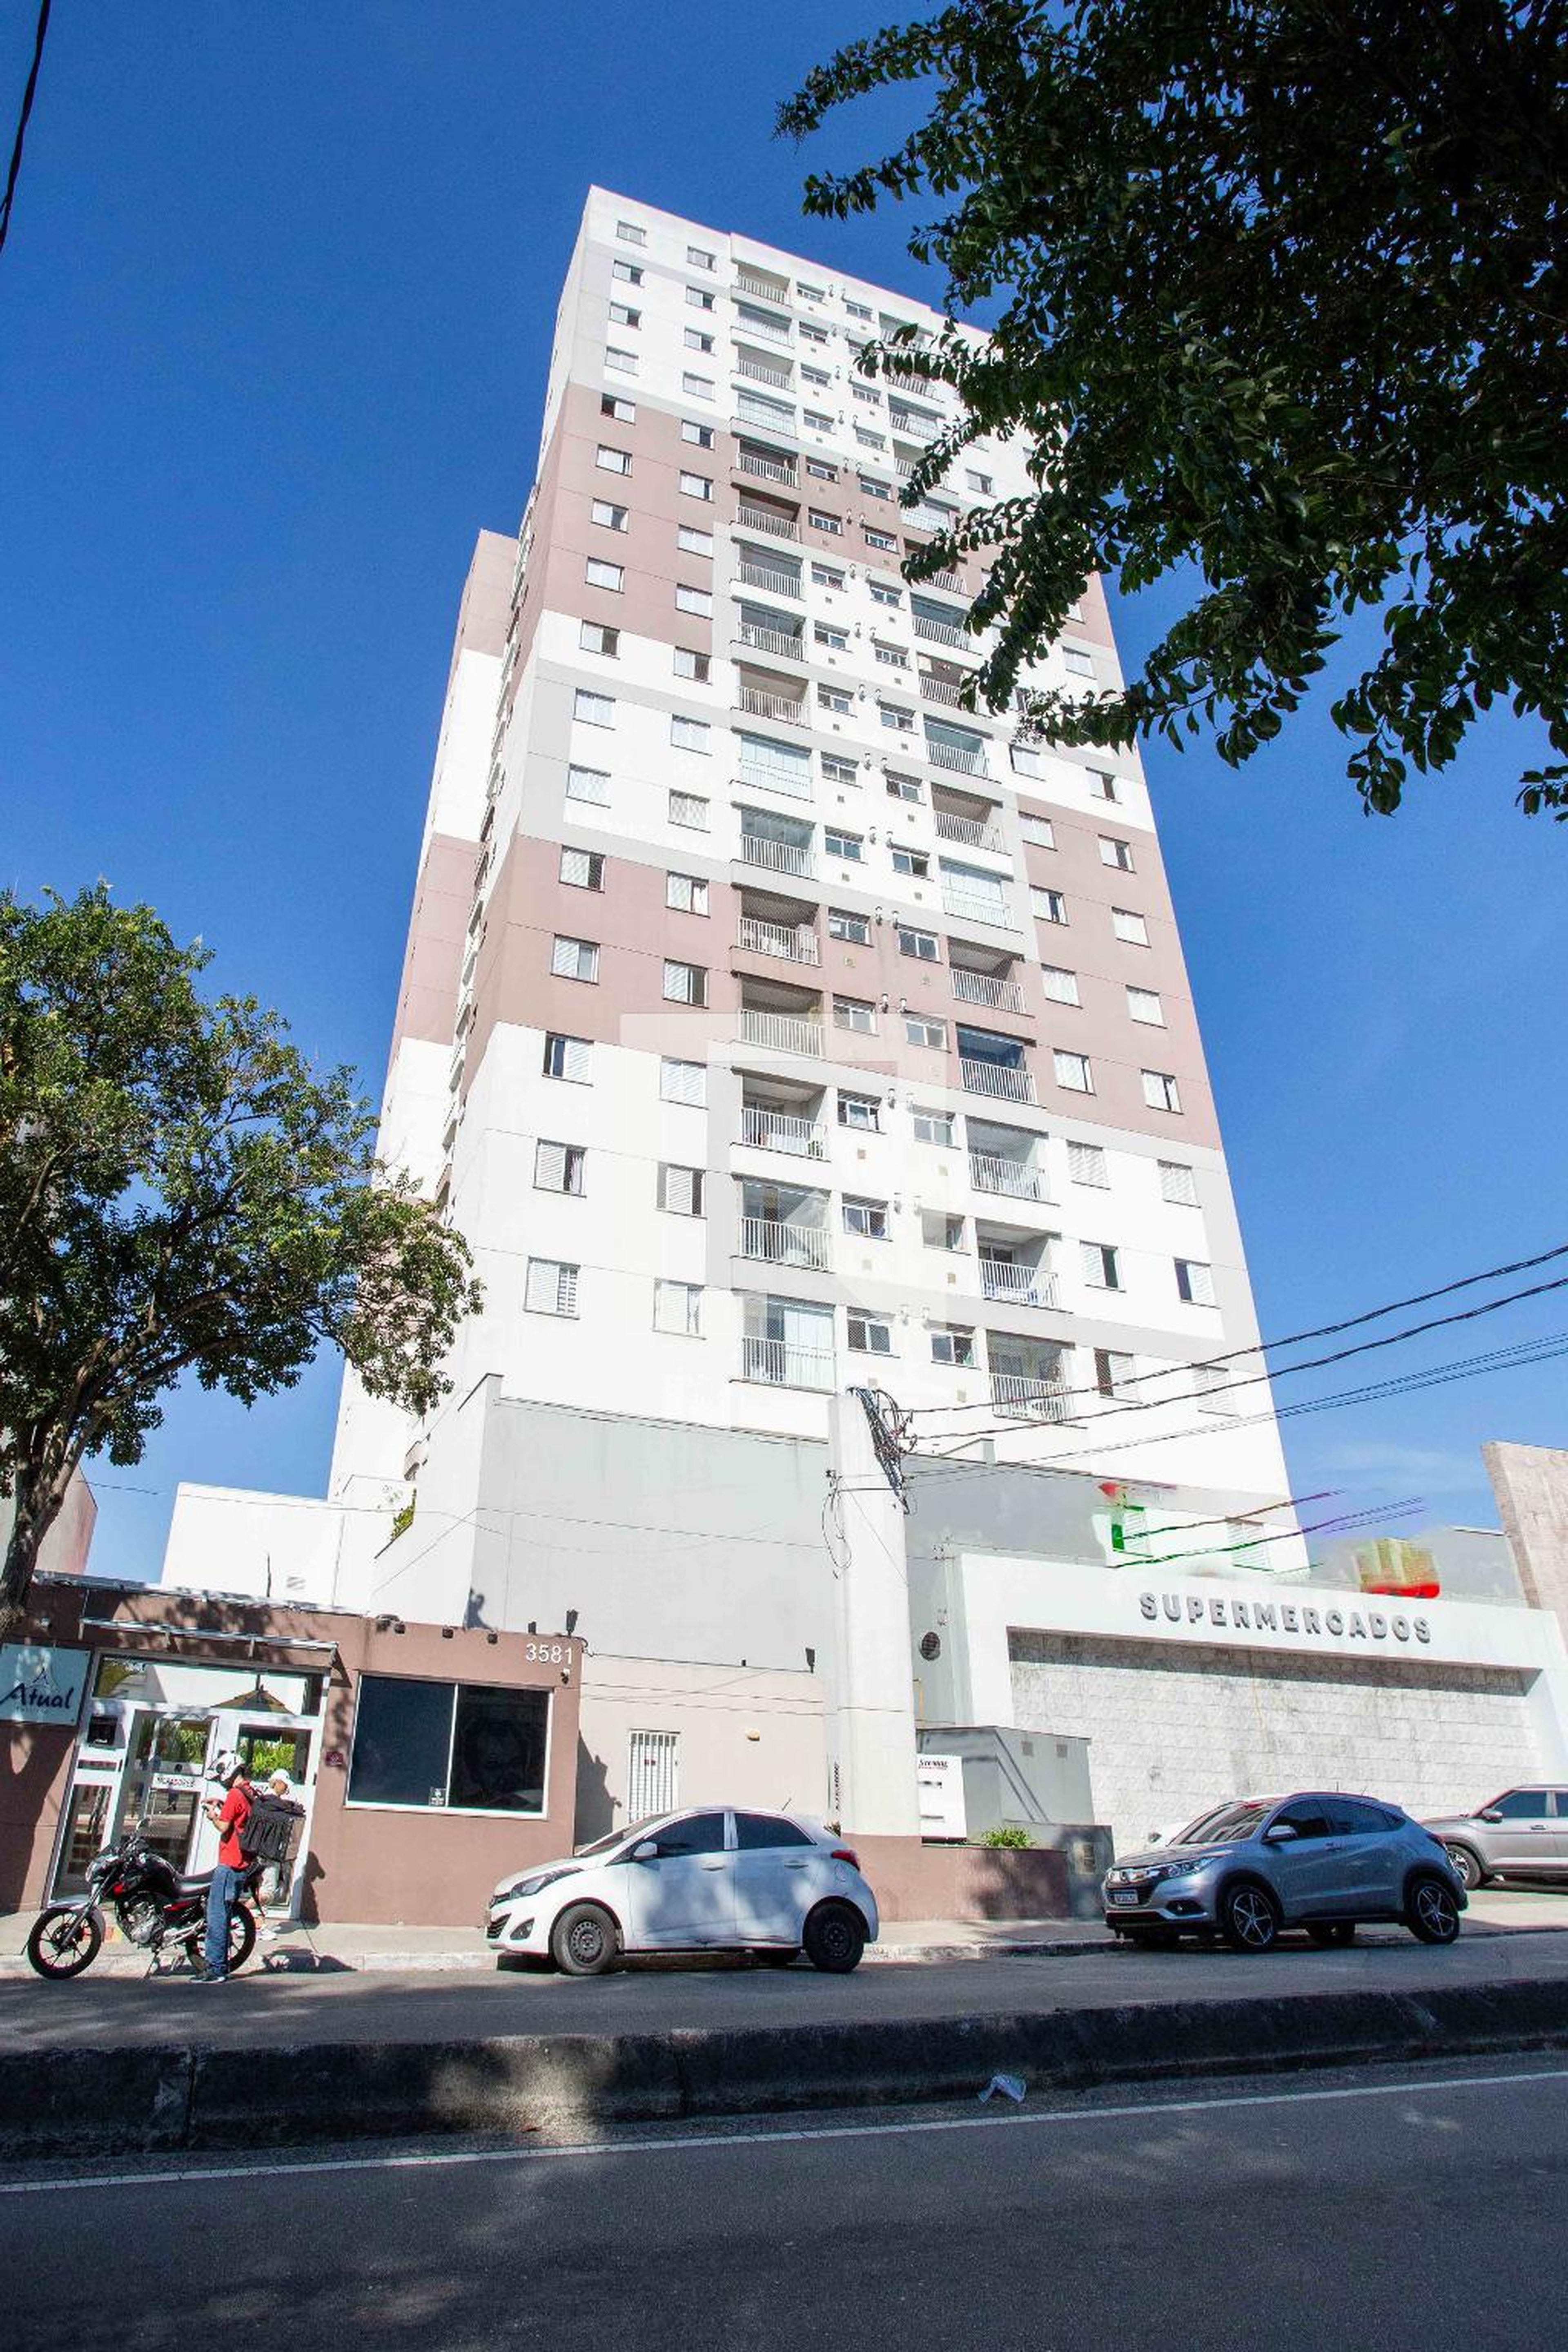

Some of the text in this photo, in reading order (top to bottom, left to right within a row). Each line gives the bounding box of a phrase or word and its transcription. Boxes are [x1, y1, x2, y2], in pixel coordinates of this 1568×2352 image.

[1140, 1592, 1431, 1643] SUPERMERCADOS
[526, 1643, 572, 1664] 3581
[0, 1683, 74, 1709] Atual
